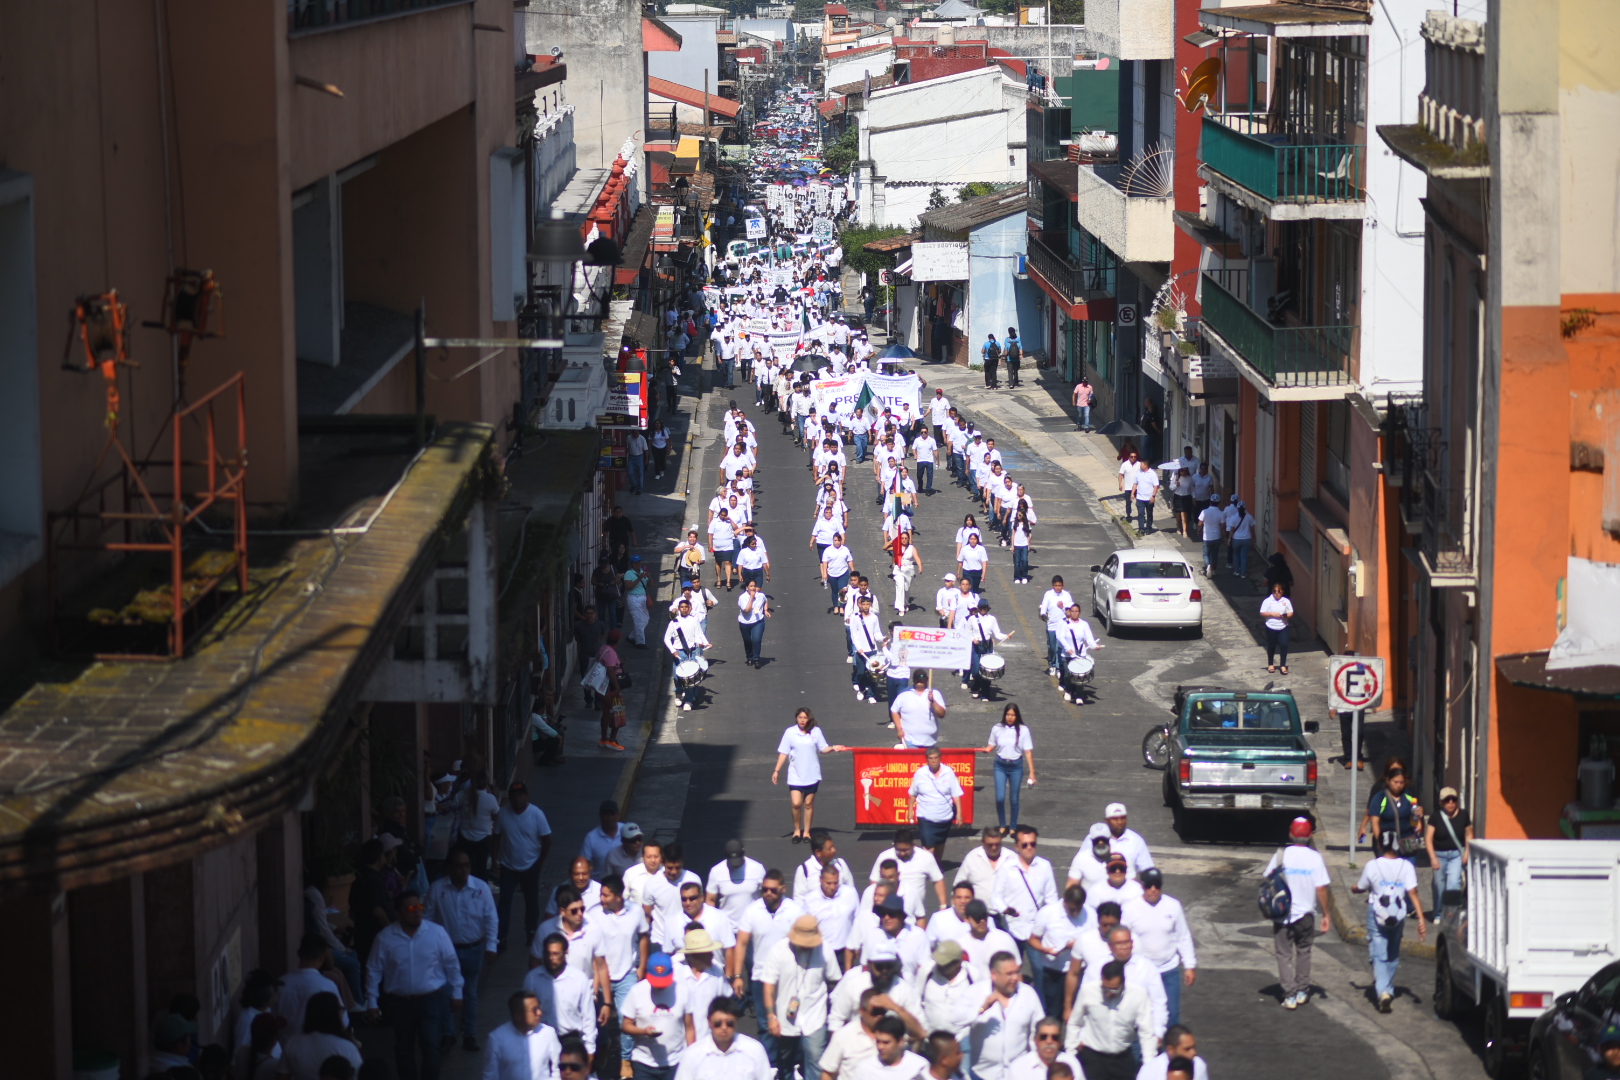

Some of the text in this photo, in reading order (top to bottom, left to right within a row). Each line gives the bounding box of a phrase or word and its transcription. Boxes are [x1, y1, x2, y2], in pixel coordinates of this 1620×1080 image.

[835, 393, 903, 406] PRENTE
[914, 632, 937, 642] CROC
[1346, 670, 1366, 697] E
[886, 762, 908, 773] UNION
